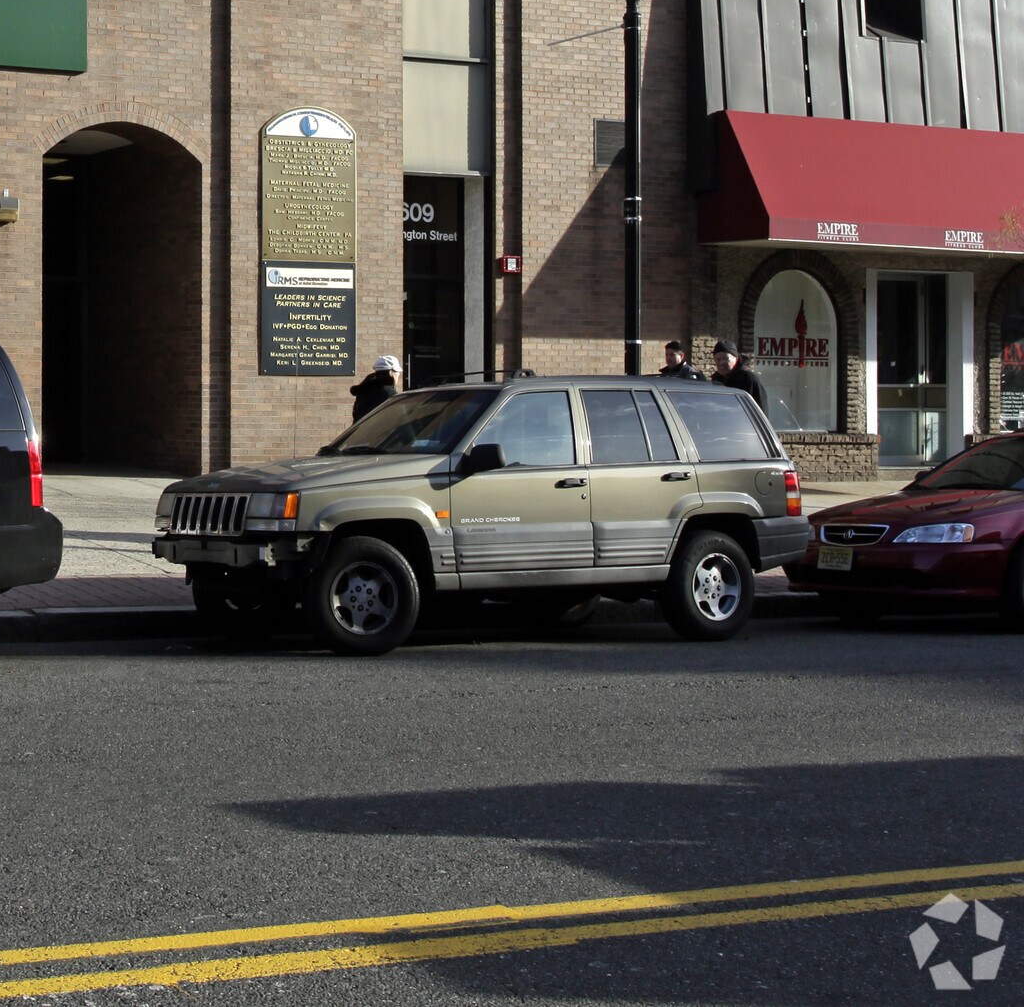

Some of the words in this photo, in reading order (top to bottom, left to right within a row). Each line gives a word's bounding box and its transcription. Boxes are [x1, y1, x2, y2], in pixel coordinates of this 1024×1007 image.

[817, 222, 859, 236] EMPIRE
[429, 230, 457, 242] Street
[944, 230, 983, 243] EMPIRE
[289, 313, 332, 321] INFERTILITY
[757, 337, 829, 357] EMPIRE
